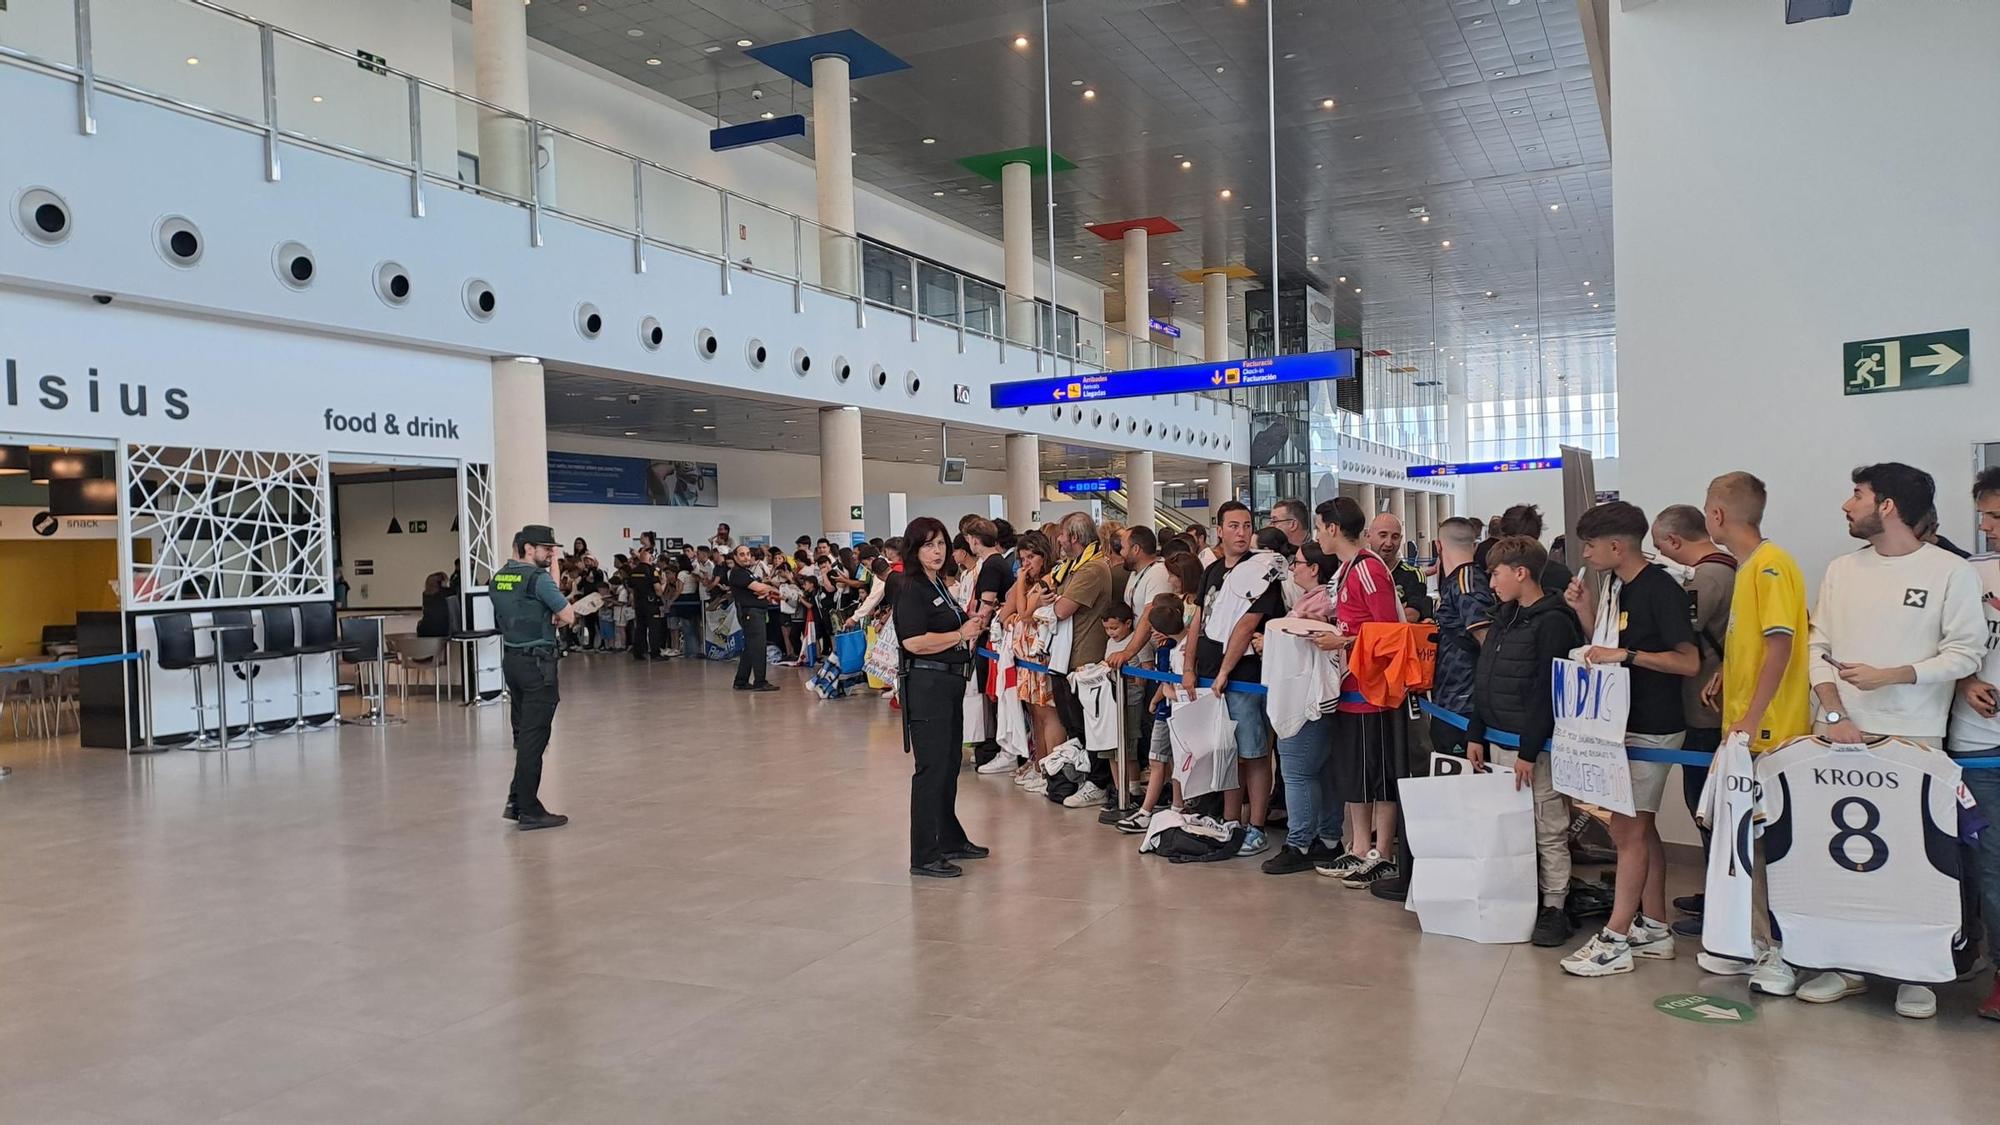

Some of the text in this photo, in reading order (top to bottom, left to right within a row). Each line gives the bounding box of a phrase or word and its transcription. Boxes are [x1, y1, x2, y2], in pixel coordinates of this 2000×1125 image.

[1242, 374, 1277, 383] Facturación
[6, 358, 190, 420] lsius
[1082, 390, 1107, 398] Llegadas
[323, 408, 460, 439] food & drink
[66, 519, 99, 529] snack
[494, 573, 522, 583] GUARDIA
[496, 582, 514, 591] CIVIL
[1089, 685, 1102, 718] 7
[1812, 768, 1899, 789] KROOS
[1829, 796, 1889, 872] 8
